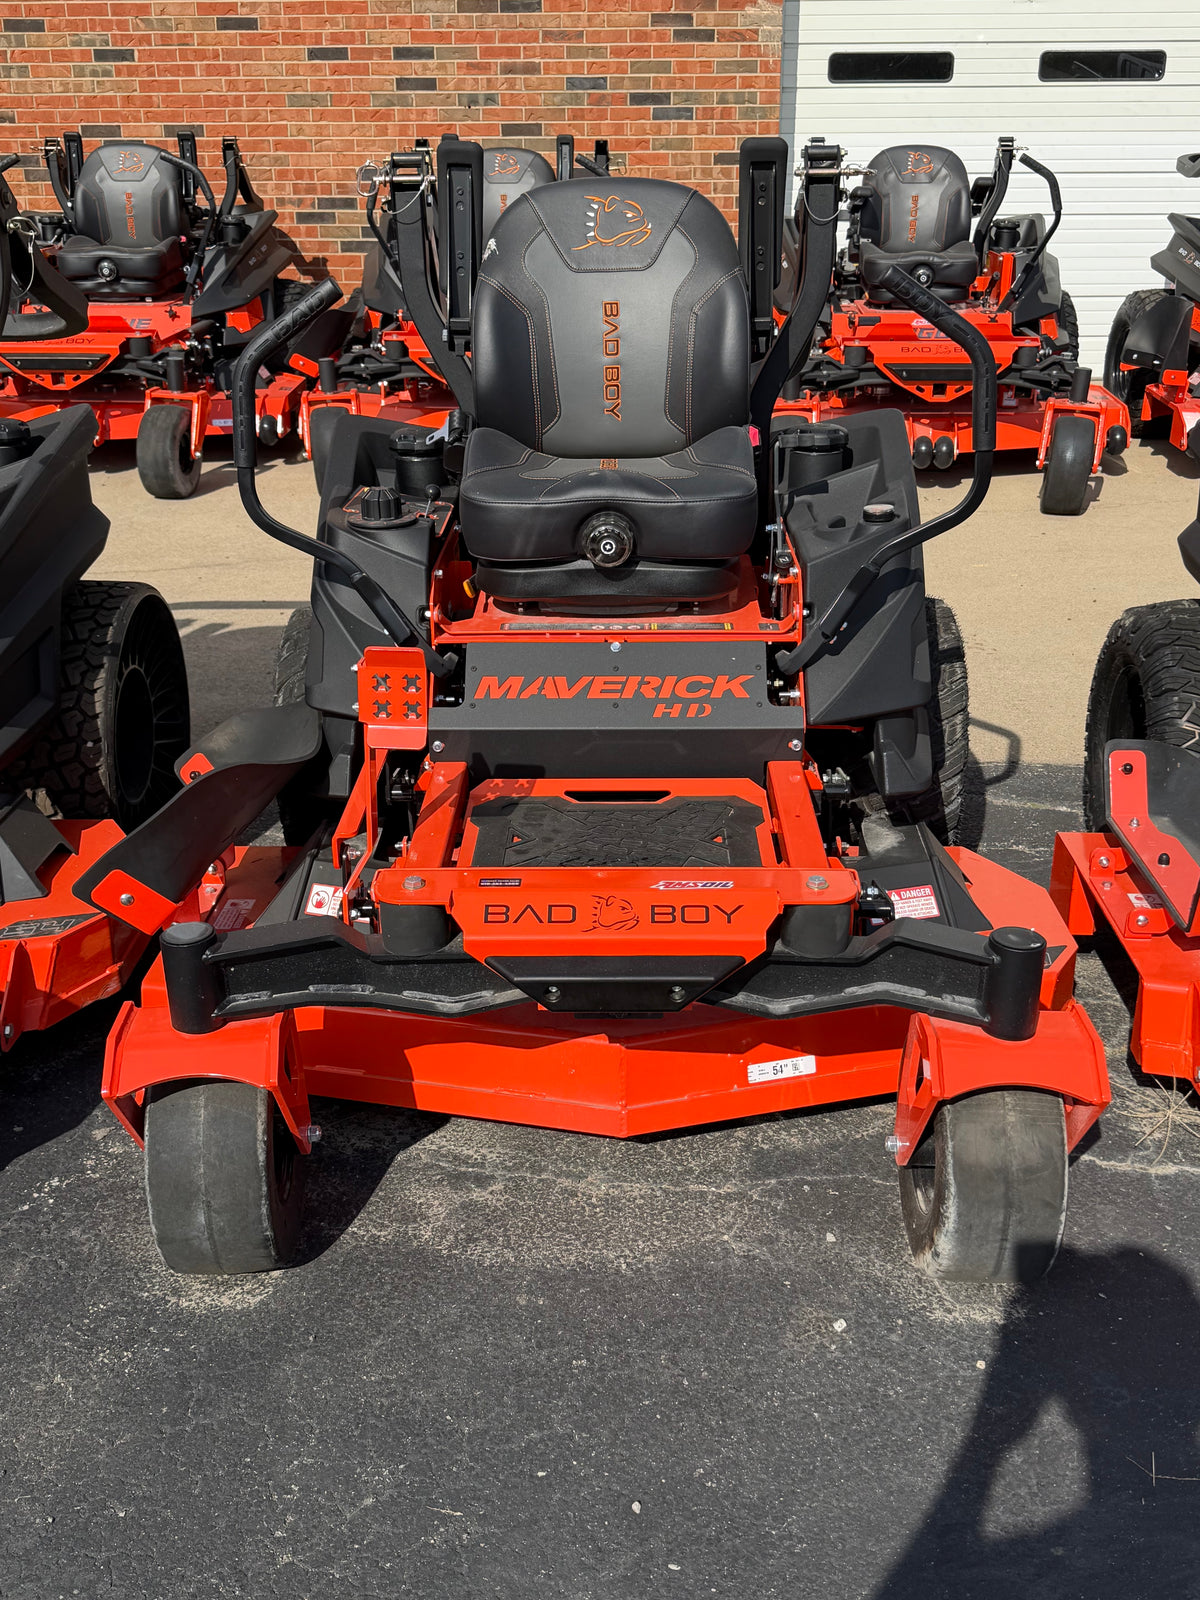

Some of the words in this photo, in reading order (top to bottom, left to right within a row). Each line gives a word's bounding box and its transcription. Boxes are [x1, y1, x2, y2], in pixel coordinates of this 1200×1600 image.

[125, 192, 133, 215] BAD
[911, 194, 919, 217] BAD
[127, 216, 136, 240] BOY
[907, 220, 917, 243] BOY
[602, 300, 620, 358] BAD
[603, 365, 622, 422] BOY
[473, 675, 755, 699] MAVERICK
[652, 703, 712, 718] HD
[652, 880, 734, 889] AMSOIL
[900, 888, 932, 899] DANGER
[483, 904, 577, 924] BAD
[650, 904, 745, 924] BOY
[772, 1063, 788, 1075] 54"
